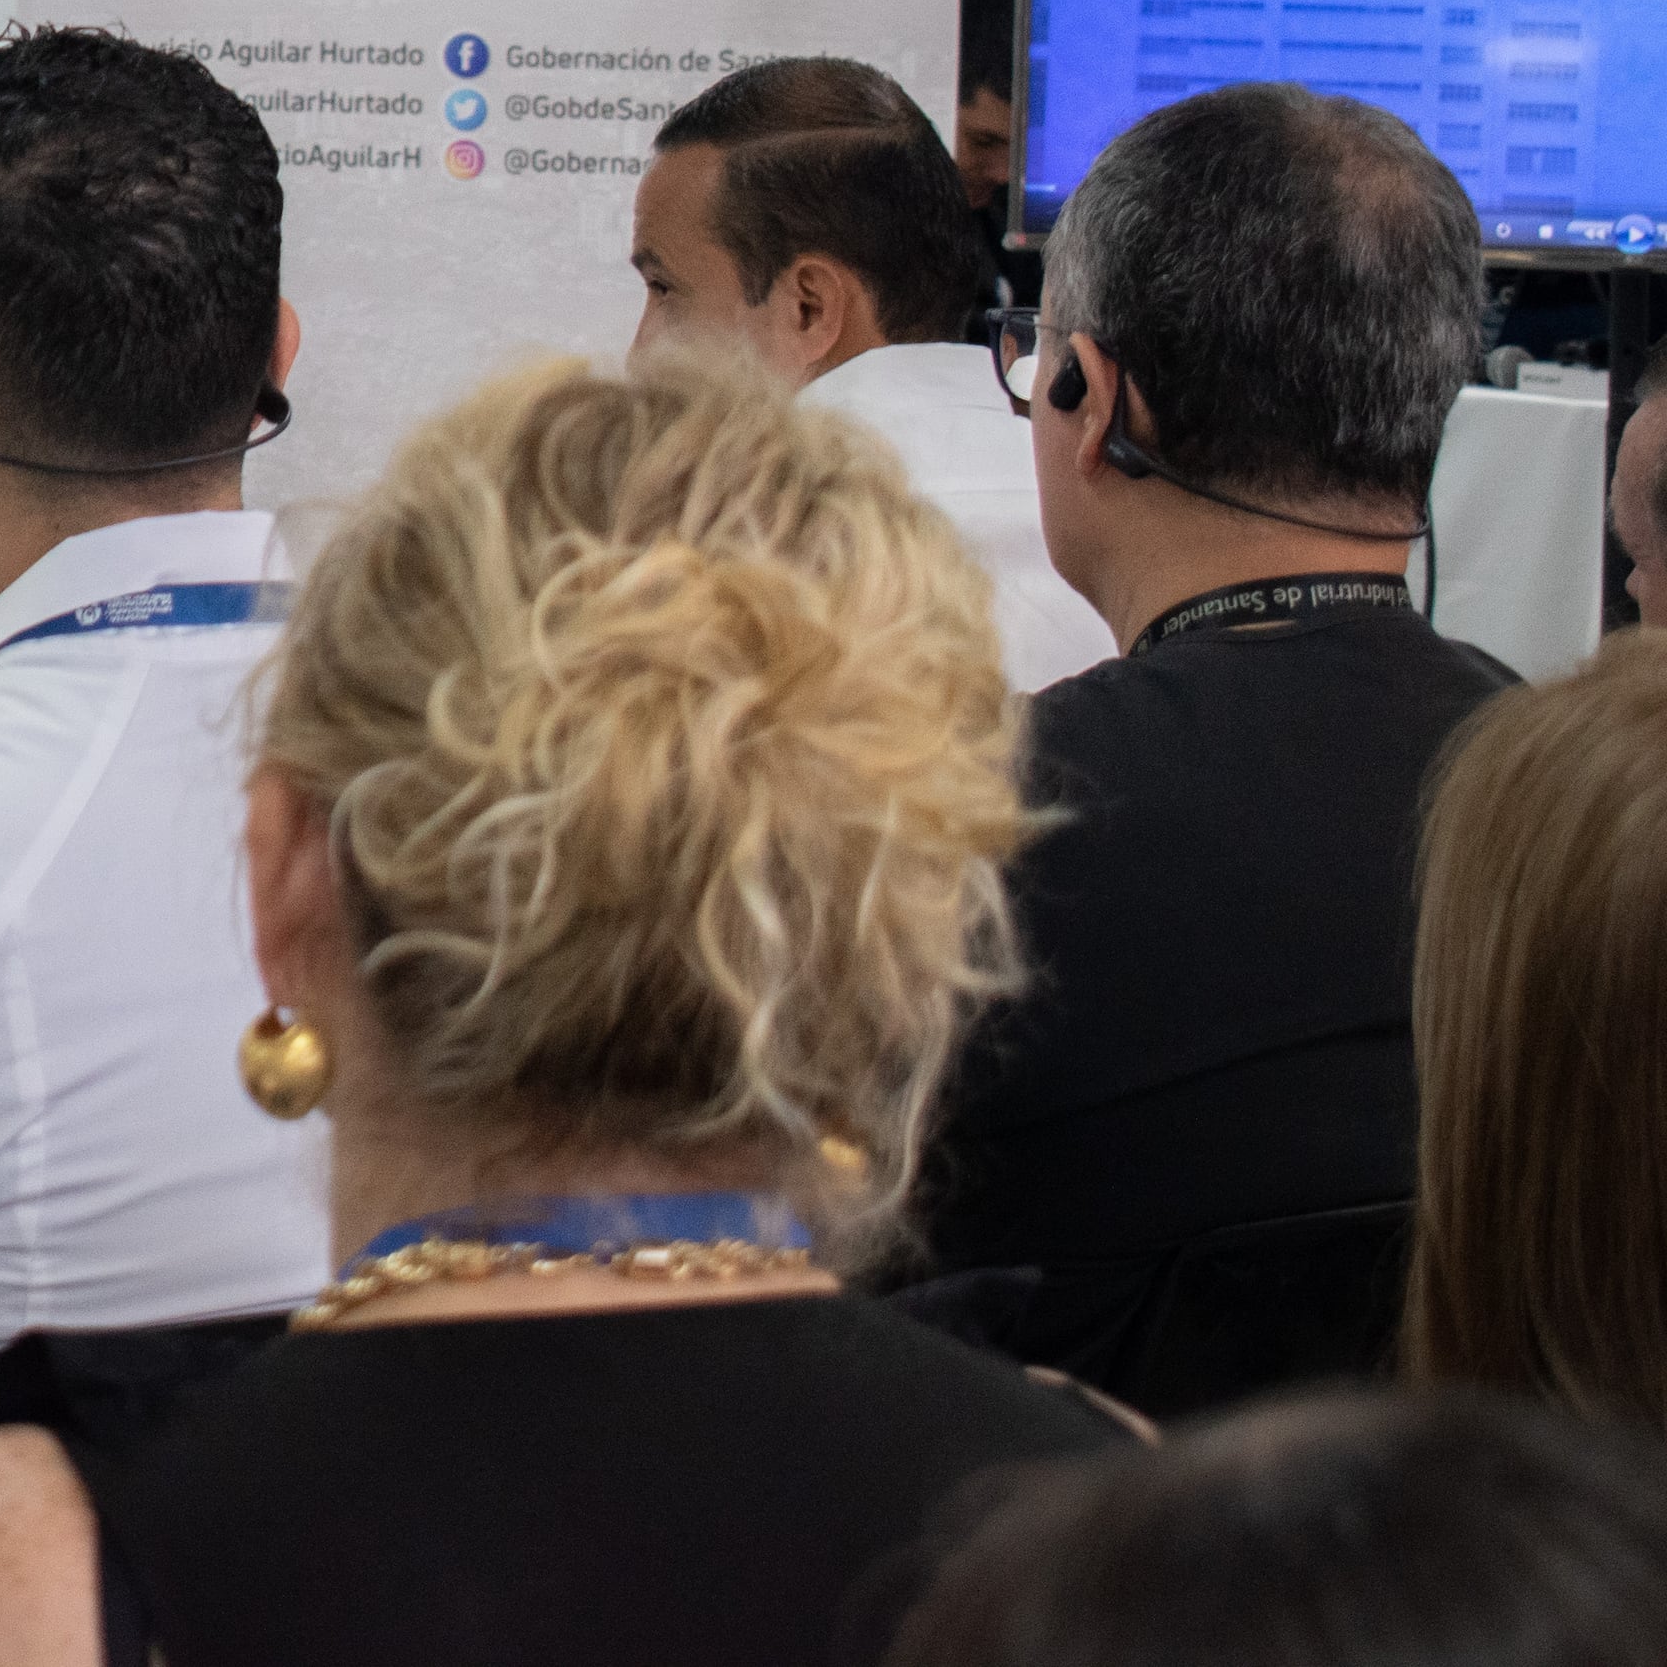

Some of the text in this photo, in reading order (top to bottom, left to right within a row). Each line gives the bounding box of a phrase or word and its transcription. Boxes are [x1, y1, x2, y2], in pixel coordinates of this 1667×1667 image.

[219, 39, 312, 67] Aguilar
[319, 41, 425, 66] Hurtado
[506, 45, 671, 72] Gobernación
[679, 47, 711, 72] de
[243, 90, 424, 115] guilarHurtado
[1273, 586, 1302, 609] de
[1162, 590, 1267, 638] Santander
